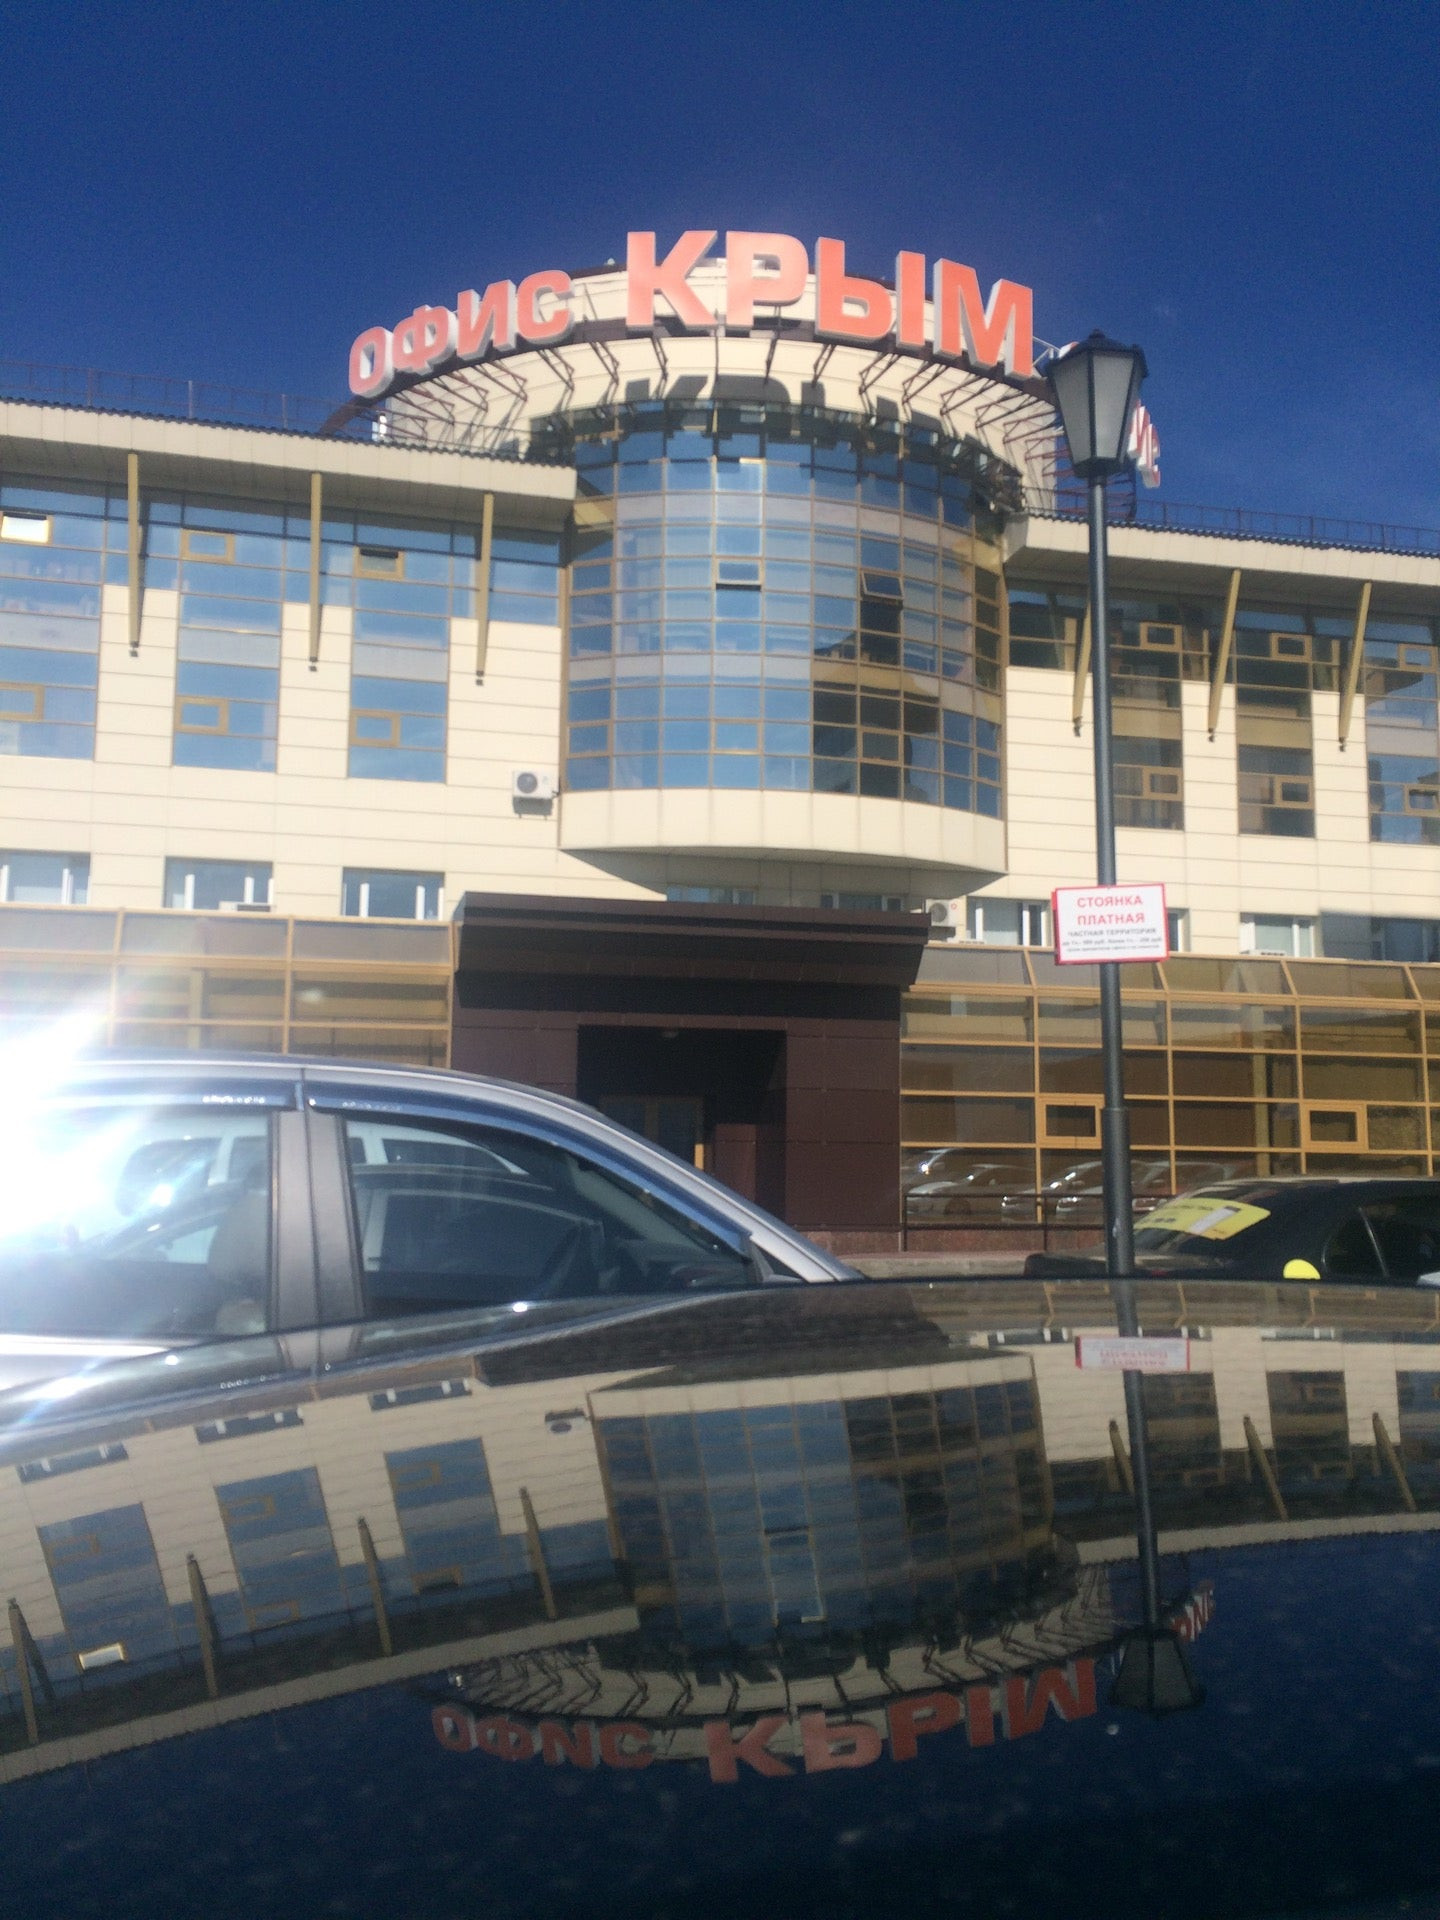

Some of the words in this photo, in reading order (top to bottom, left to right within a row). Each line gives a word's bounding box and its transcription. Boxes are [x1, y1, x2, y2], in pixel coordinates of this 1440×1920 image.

[349, 270, 575, 398] ОФИС
[626, 230, 1033, 379] КРЫМ
[1077, 895, 1144, 908] СТОЯНКА
[1077, 913, 1146, 926] ПЛАТНАЯ
[1106, 928, 1157, 937] ТЕРРИТОРИЯ
